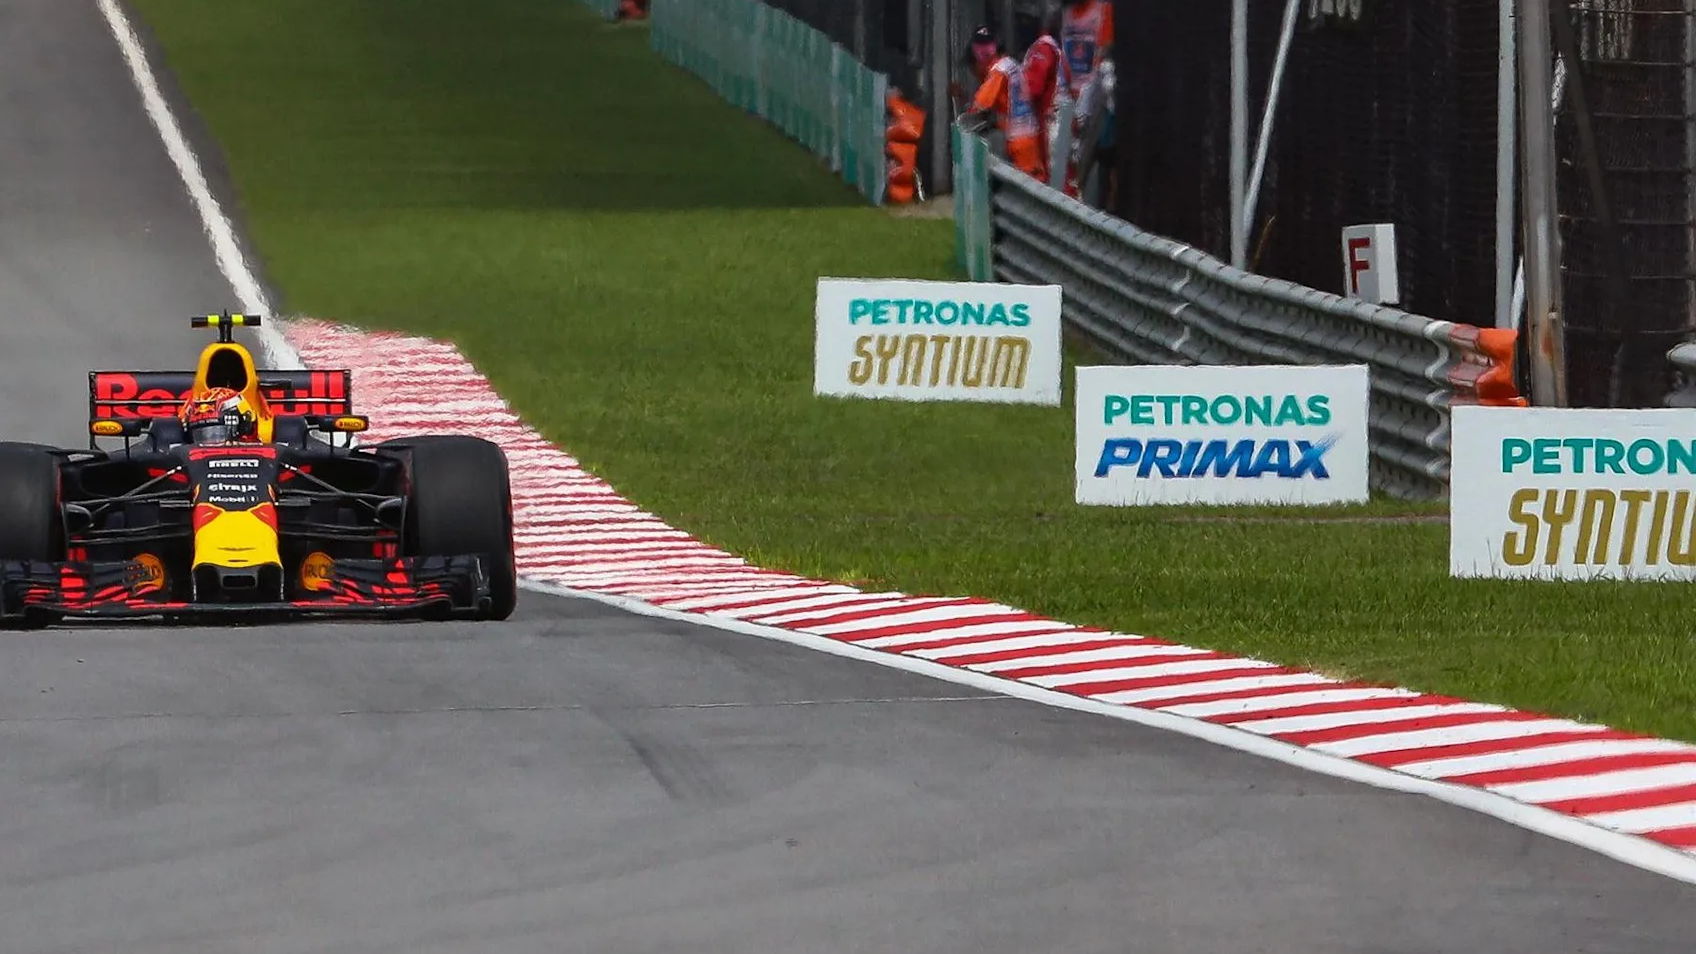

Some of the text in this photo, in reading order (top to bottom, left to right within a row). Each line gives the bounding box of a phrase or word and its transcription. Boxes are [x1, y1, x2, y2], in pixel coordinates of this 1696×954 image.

[1348, 236, 1370, 294] F
[849, 298, 1030, 327] PETRONAS
[848, 333, 1030, 389] SYNTIUM
[97, 372, 344, 418] Re ull
[1104, 394, 1332, 426] PETRONAS
[208, 459, 259, 468] PIRELLI
[1094, 433, 1344, 479] PRIMAX
[1502, 438, 1696, 475] PETRON
[1503, 489, 1696, 566] SYNTIU
